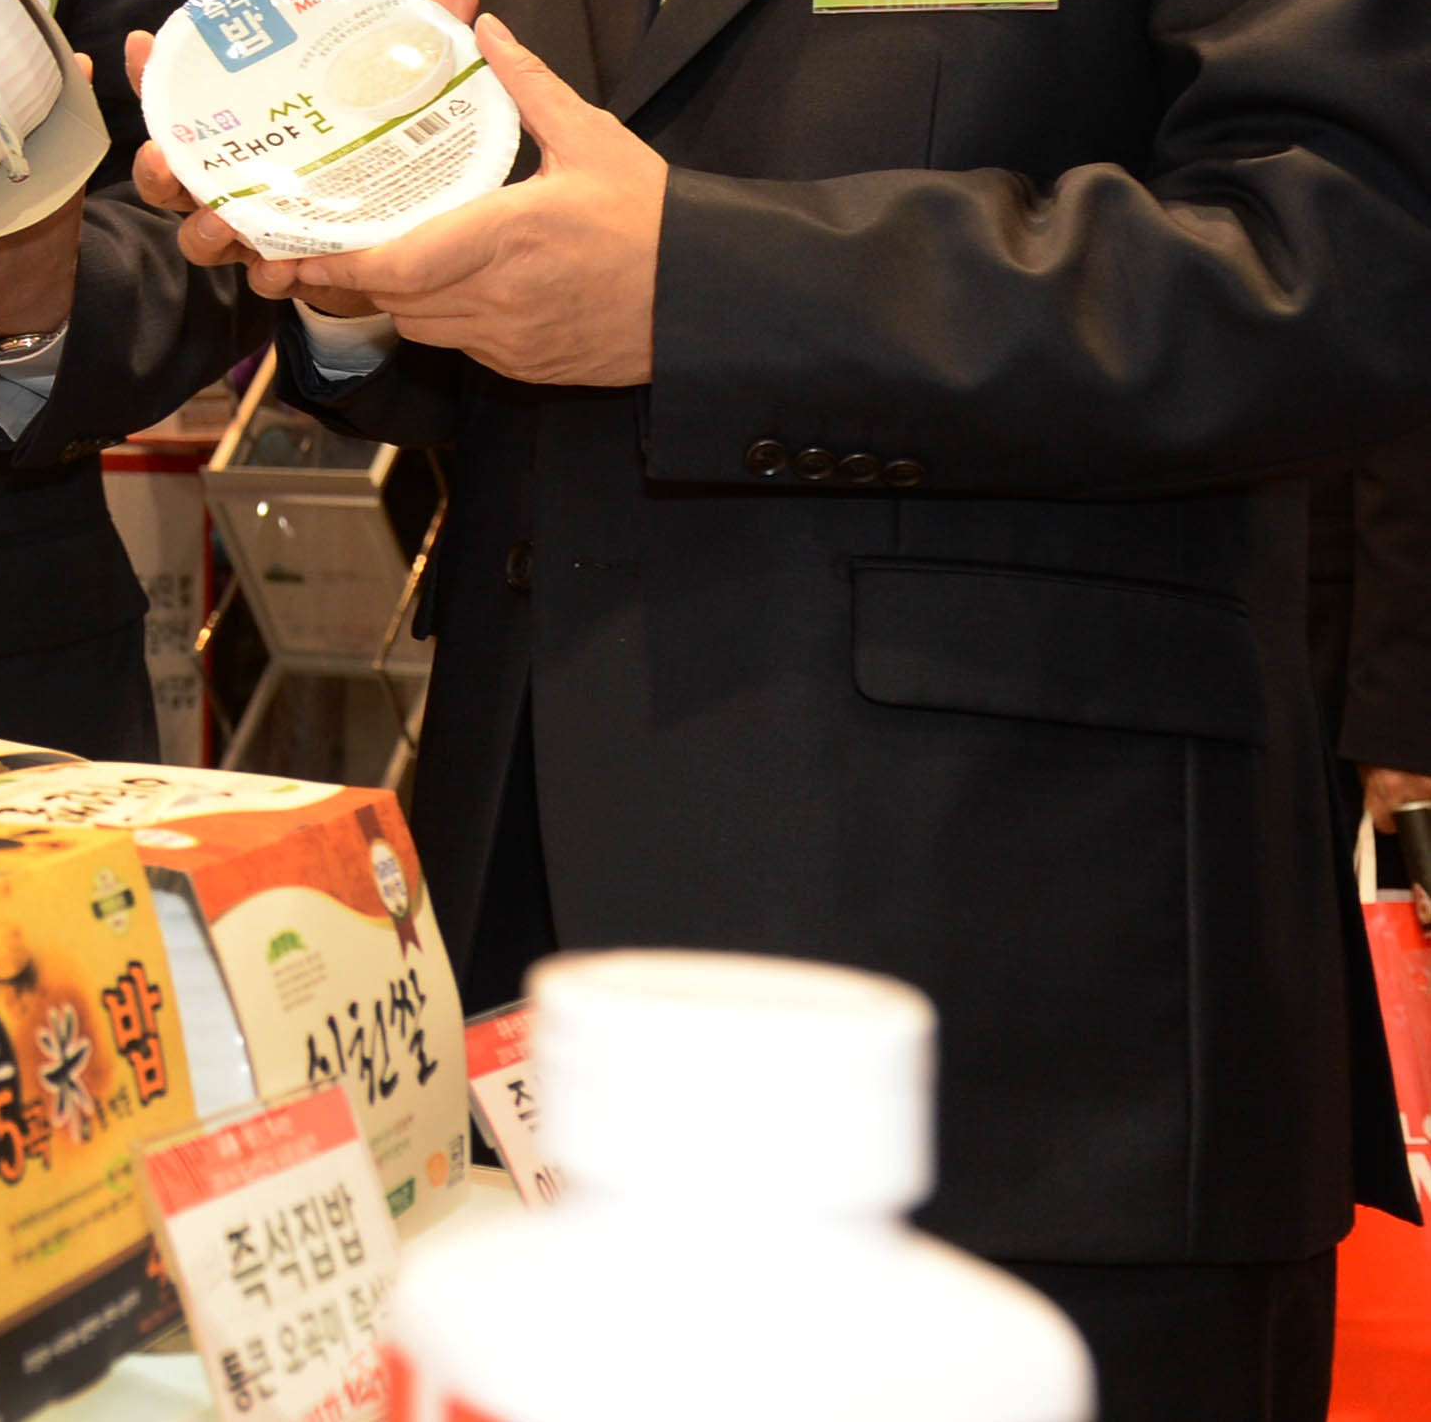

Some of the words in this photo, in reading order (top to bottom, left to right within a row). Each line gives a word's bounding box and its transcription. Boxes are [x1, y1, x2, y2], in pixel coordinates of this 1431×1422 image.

[101, 959, 168, 1107] 밥
[225, 1182, 367, 1309] 즉석집밥
[220, 1333, 279, 1413] 통큰
